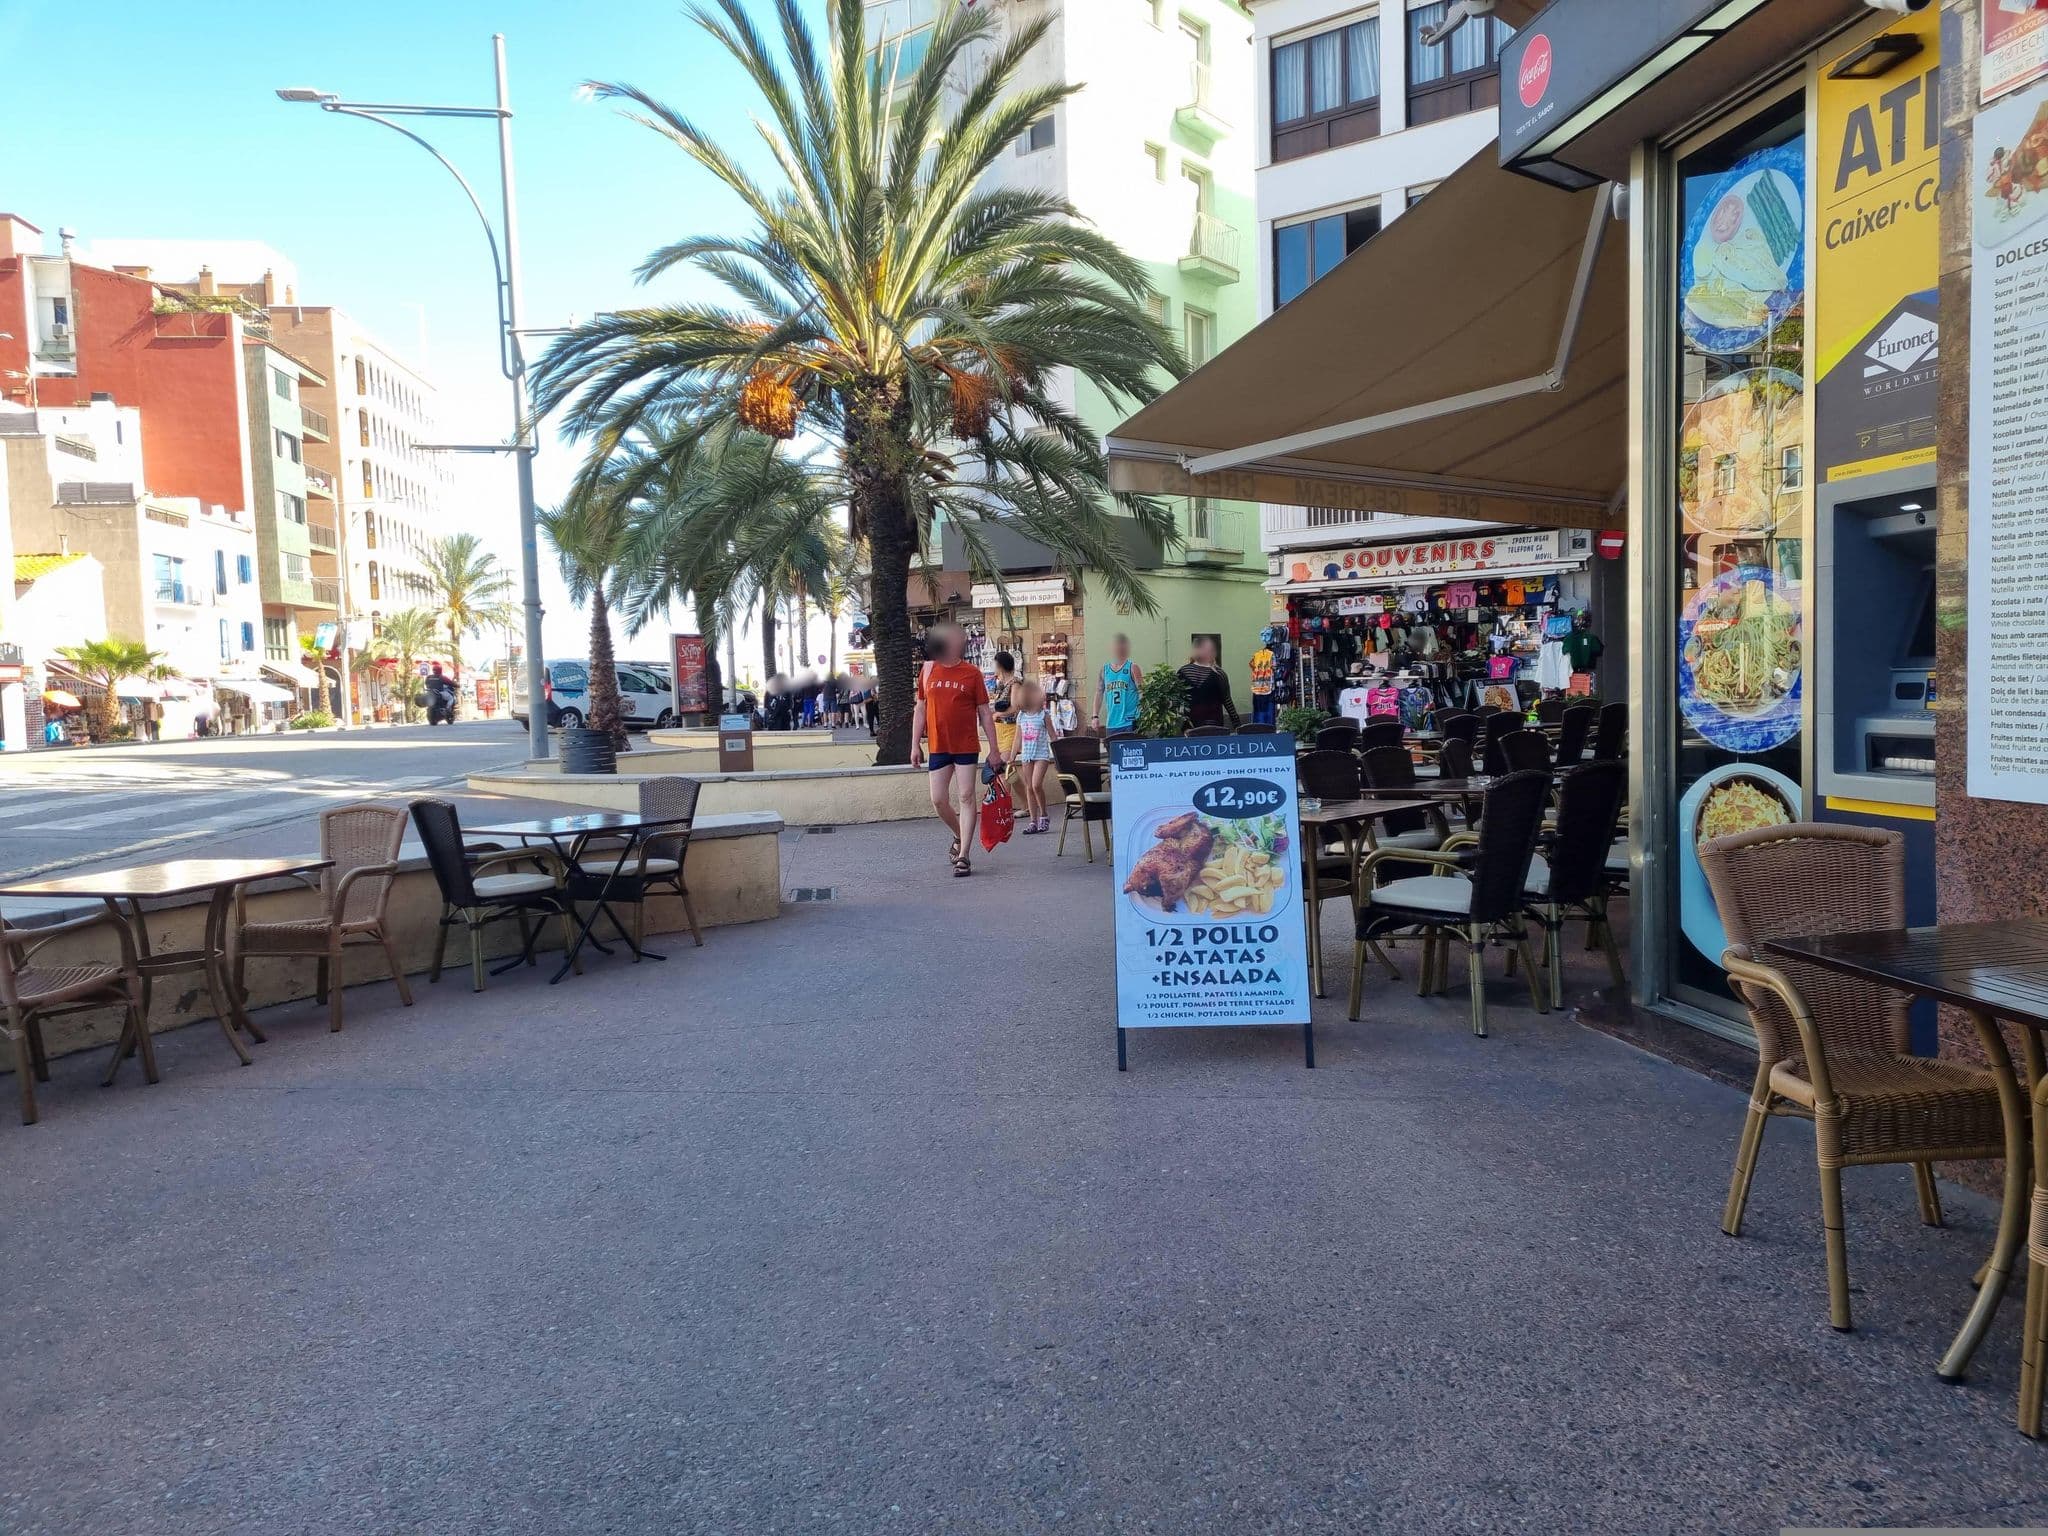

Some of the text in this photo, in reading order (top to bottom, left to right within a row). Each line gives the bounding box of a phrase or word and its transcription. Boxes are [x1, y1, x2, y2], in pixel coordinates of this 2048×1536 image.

[1520, 51, 1548, 90] Coca-Cola
[1826, 200, 1902, 250] Caixer
[1996, 238, 2048, 268] DOLCES
[1876, 329, 1934, 358] Euronet
[1993, 416, 2022, 427] Xocolata
[1993, 424, 2047, 440] Xocolata blanca
[1992, 436, 2044, 452] Nous caramel
[1992, 478, 2010, 486] Gelat
[1992, 486, 2034, 499] Nutella amb
[1992, 509, 2034, 520] Nutella amb
[1992, 530, 2034, 542] Nutella amb
[1342, 539, 1496, 571] SOUVENIRS
[1992, 553, 2034, 563] Nutella amb
[1992, 576, 2016, 584] Nutella
[1038, 593, 1058, 601] spain
[1456, 594, 1472, 608] 10
[1992, 596, 2020, 606] Xocolata
[1992, 609, 2046, 618] Xocolata blanca
[1114, 692, 1120, 704] 2
[2004, 709, 2046, 717] condensada
[1990, 721, 2014, 729] Fruites
[1990, 734, 2013, 742] Fruites
[1165, 742, 1277, 758] PLATO DEL DIA
[2014, 756, 2038, 764] mixtes
[1990, 764, 2010, 772] Mixed
[1204, 786, 1279, 812] 12,90€
[1145, 924, 1280, 946] 1/2 POLLO
[1156, 948, 1266, 966] +PATATAS
[1152, 968, 1282, 986] +ENSALADA
